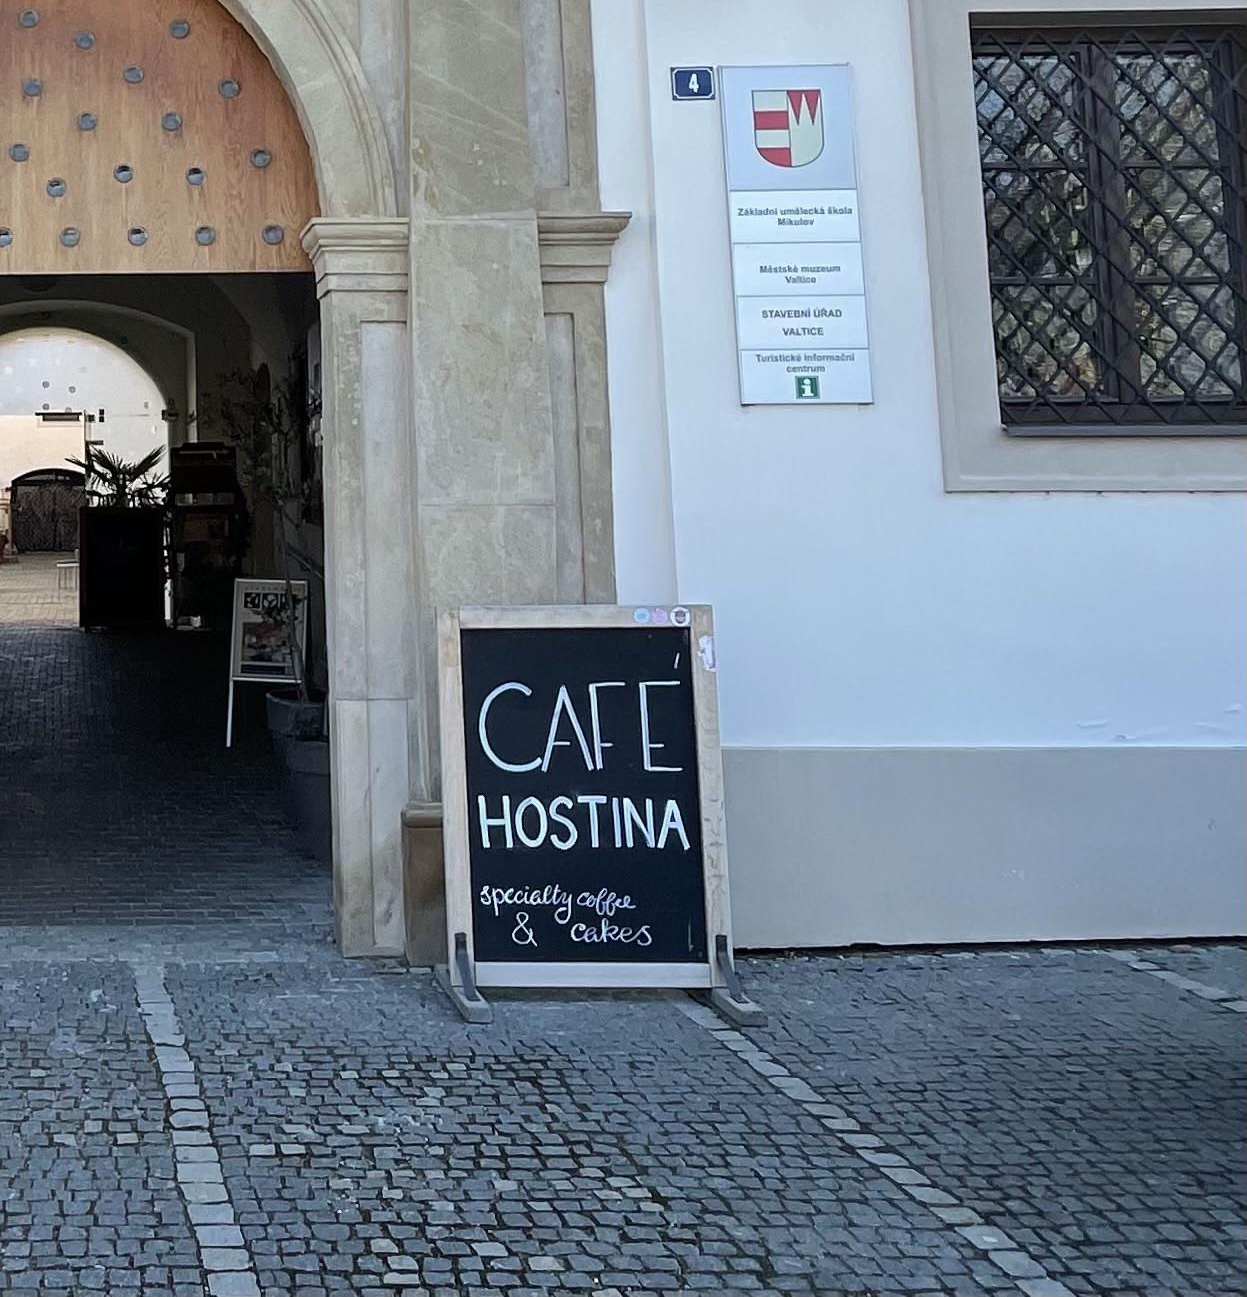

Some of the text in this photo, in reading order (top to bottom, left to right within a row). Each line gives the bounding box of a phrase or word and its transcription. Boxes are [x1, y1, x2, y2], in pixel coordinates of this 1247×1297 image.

[688, 73, 699, 93] 4
[737, 207, 778, 216] Základní
[827, 206, 853, 215] škola
[777, 217, 814, 226] Mikulov
[759, 265, 841, 273] Městské muzeum
[785, 275, 817, 284] Valtice
[761, 307, 843, 318] STAVEBNÍ ÚŘAD
[782, 327, 824, 336] VALTICE
[755, 352, 855, 363] Turistické informační
[786, 364, 826, 373] centrum
[478, 652, 683, 772] CAFÉ
[477, 794, 691, 851] HOSTINA
[479, 883, 636, 924] specialty coffee
[511, 911, 653, 947] & cakes
